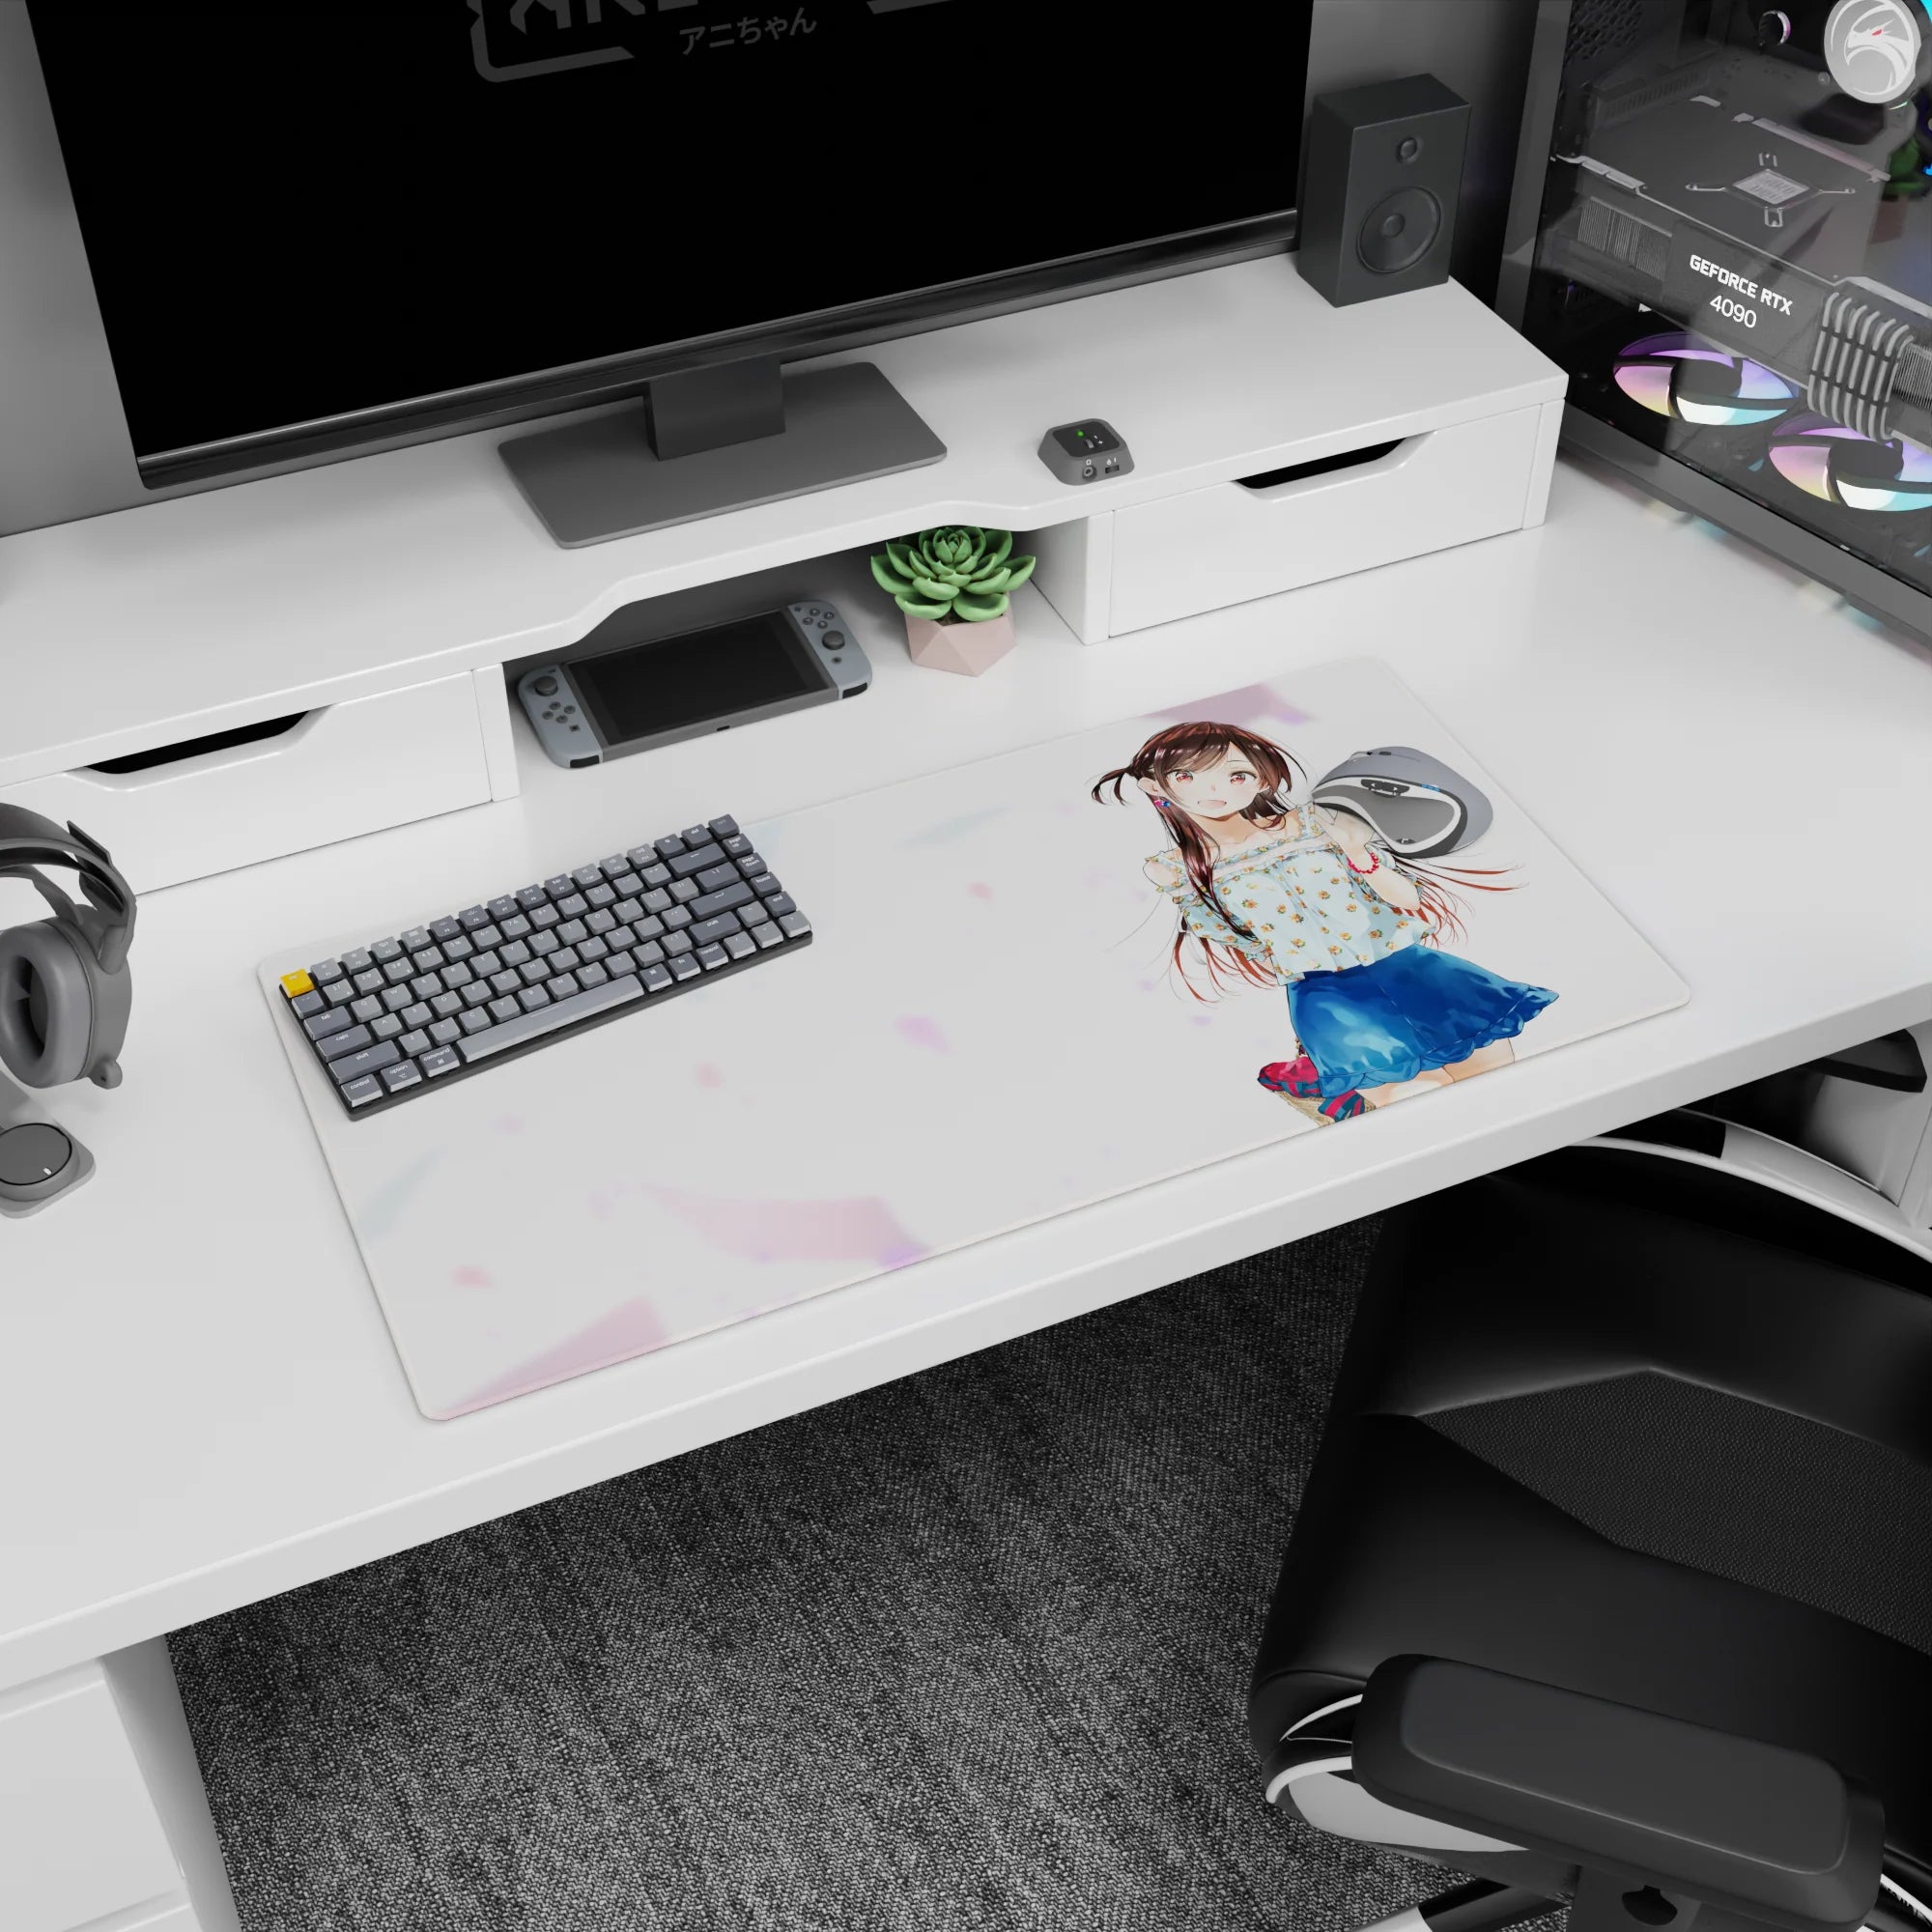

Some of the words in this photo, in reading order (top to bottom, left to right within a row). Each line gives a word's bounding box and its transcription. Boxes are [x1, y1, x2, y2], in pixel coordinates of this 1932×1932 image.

[679, 8, 817, 56] アニちゃん
[1690, 254, 1758, 298] GEFORCE
[1760, 287, 1793, 316] RTX
[1710, 295, 1757, 328] 4090
[355, 1052, 369, 1061] shift
[423, 1047, 450, 1062] command
[389, 1065, 409, 1074] option
[350, 1078, 370, 1090] control
